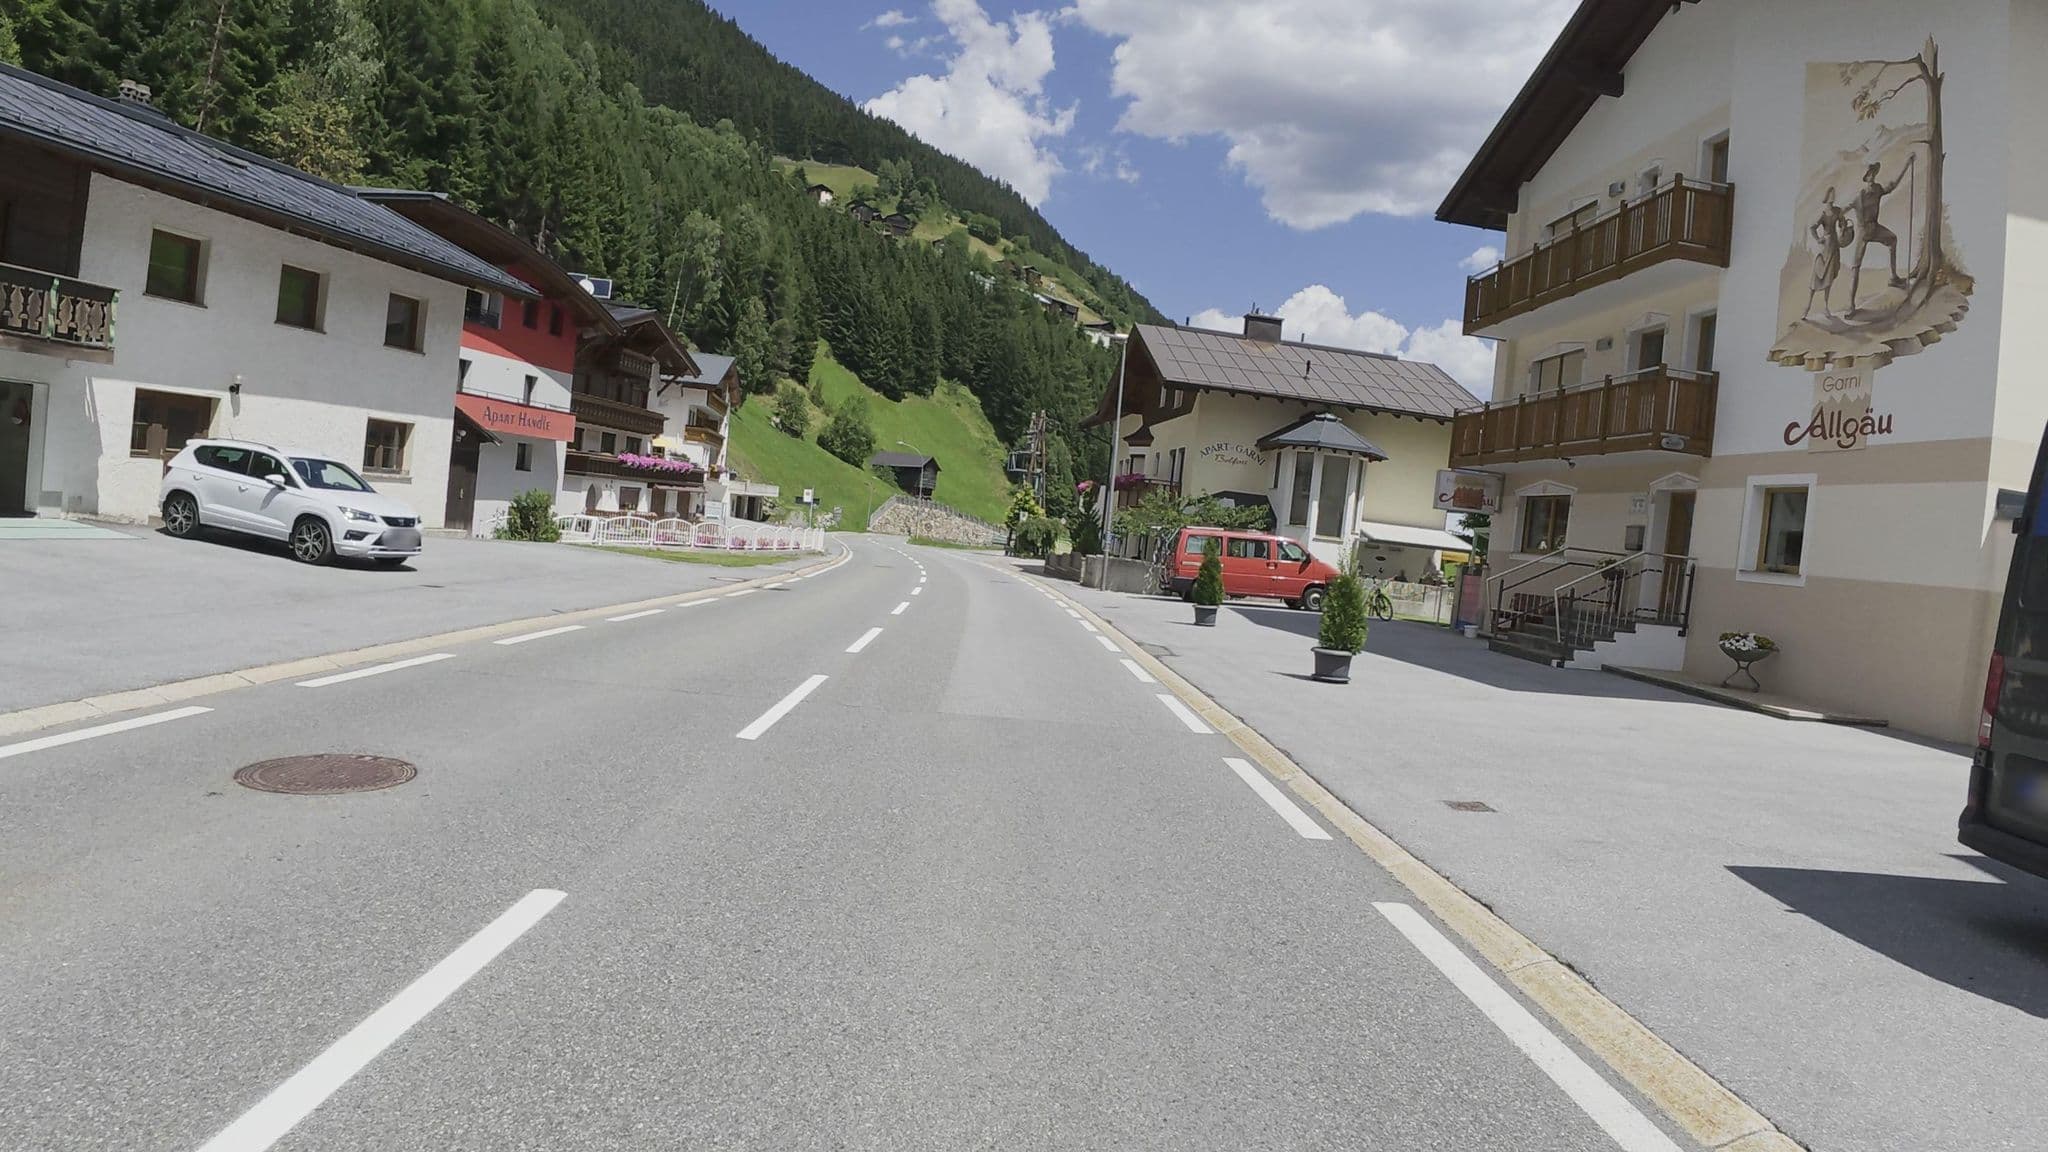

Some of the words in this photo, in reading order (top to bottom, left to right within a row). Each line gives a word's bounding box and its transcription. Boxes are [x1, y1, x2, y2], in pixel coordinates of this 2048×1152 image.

[1823, 375, 1862, 392] Garni
[1783, 405, 1893, 449] Allgäu
[1200, 442, 1229, 459] APART
[1235, 444, 1266, 466] GARNI
